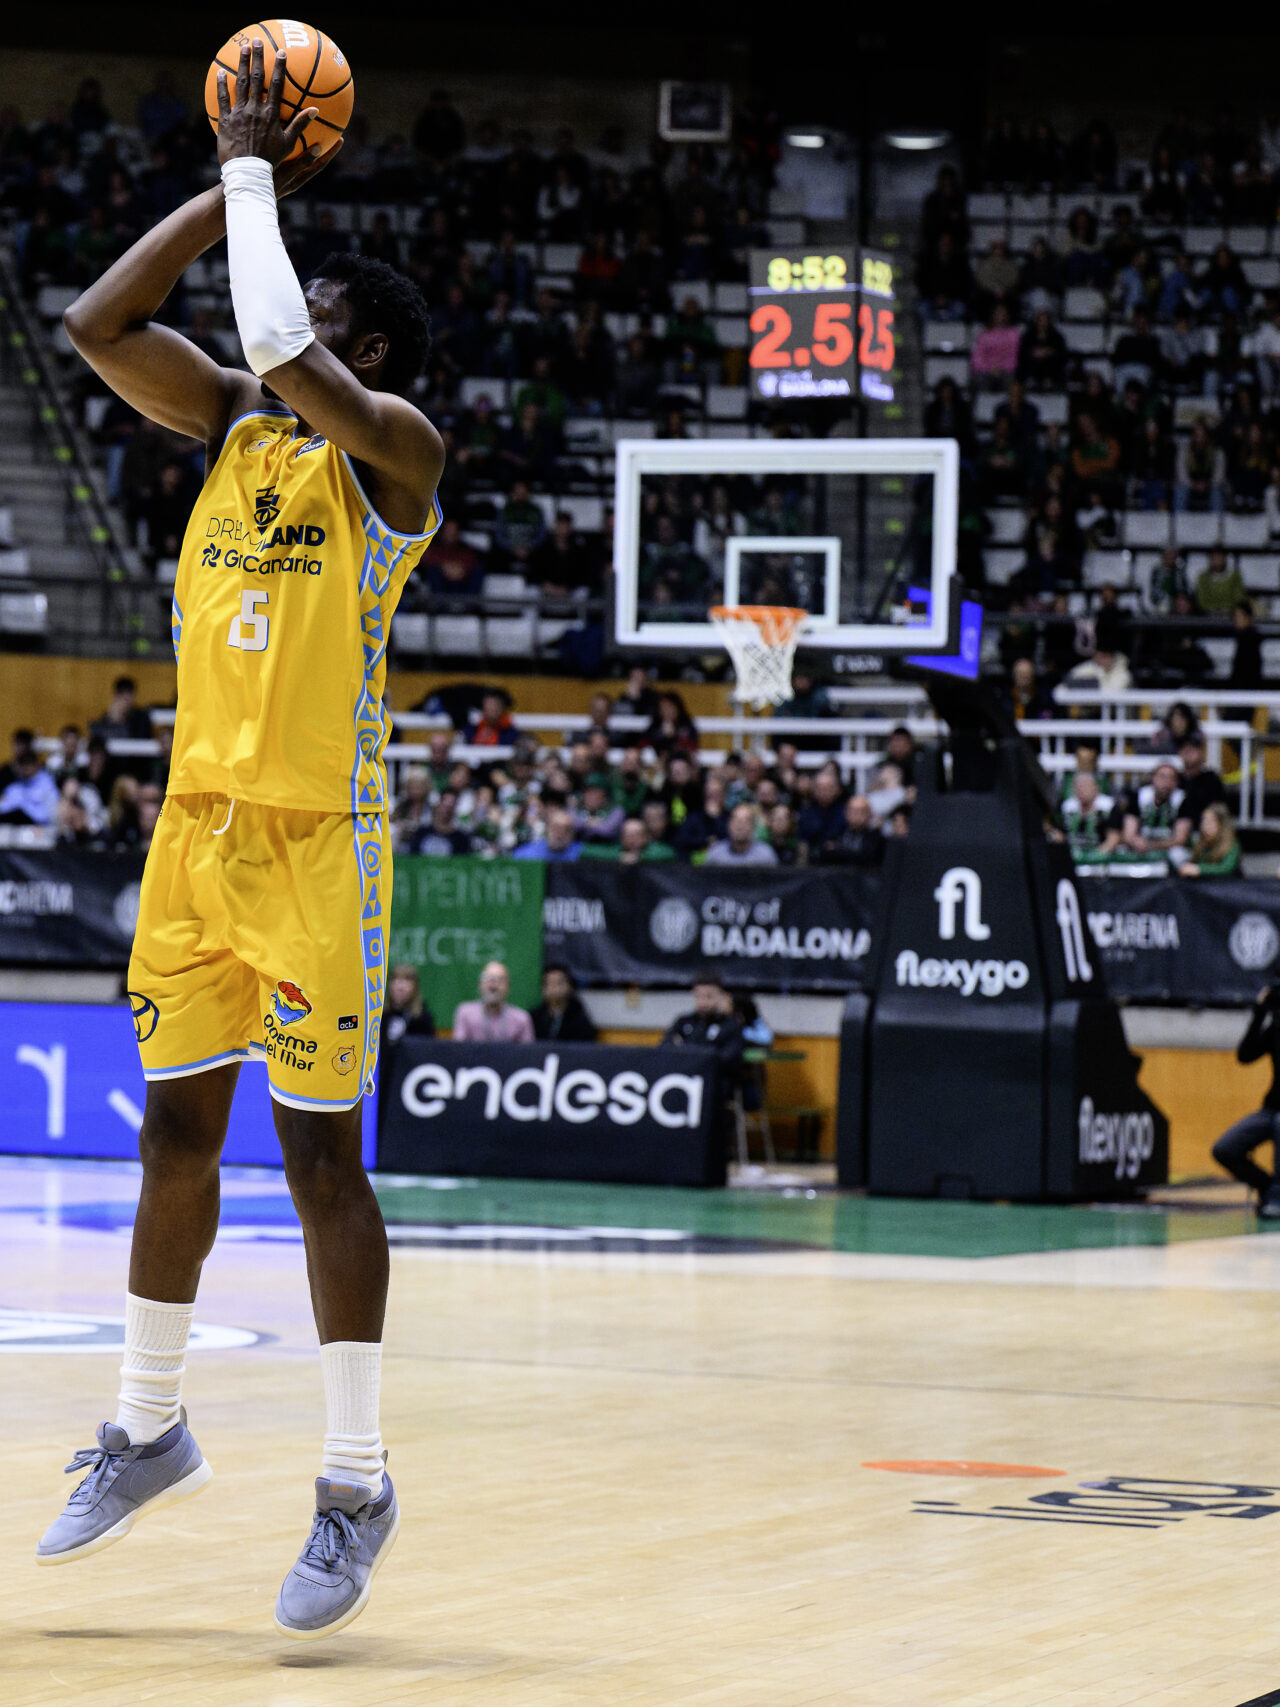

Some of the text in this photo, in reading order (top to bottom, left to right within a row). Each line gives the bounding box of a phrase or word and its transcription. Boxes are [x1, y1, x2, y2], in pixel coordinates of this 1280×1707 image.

[749, 303, 854, 368] 2.5
[702, 896, 782, 926] City of
[896, 950, 1029, 997] flexygo
[401, 1054, 705, 1129] endesa
[1078, 1096, 1154, 1179] flexygo
